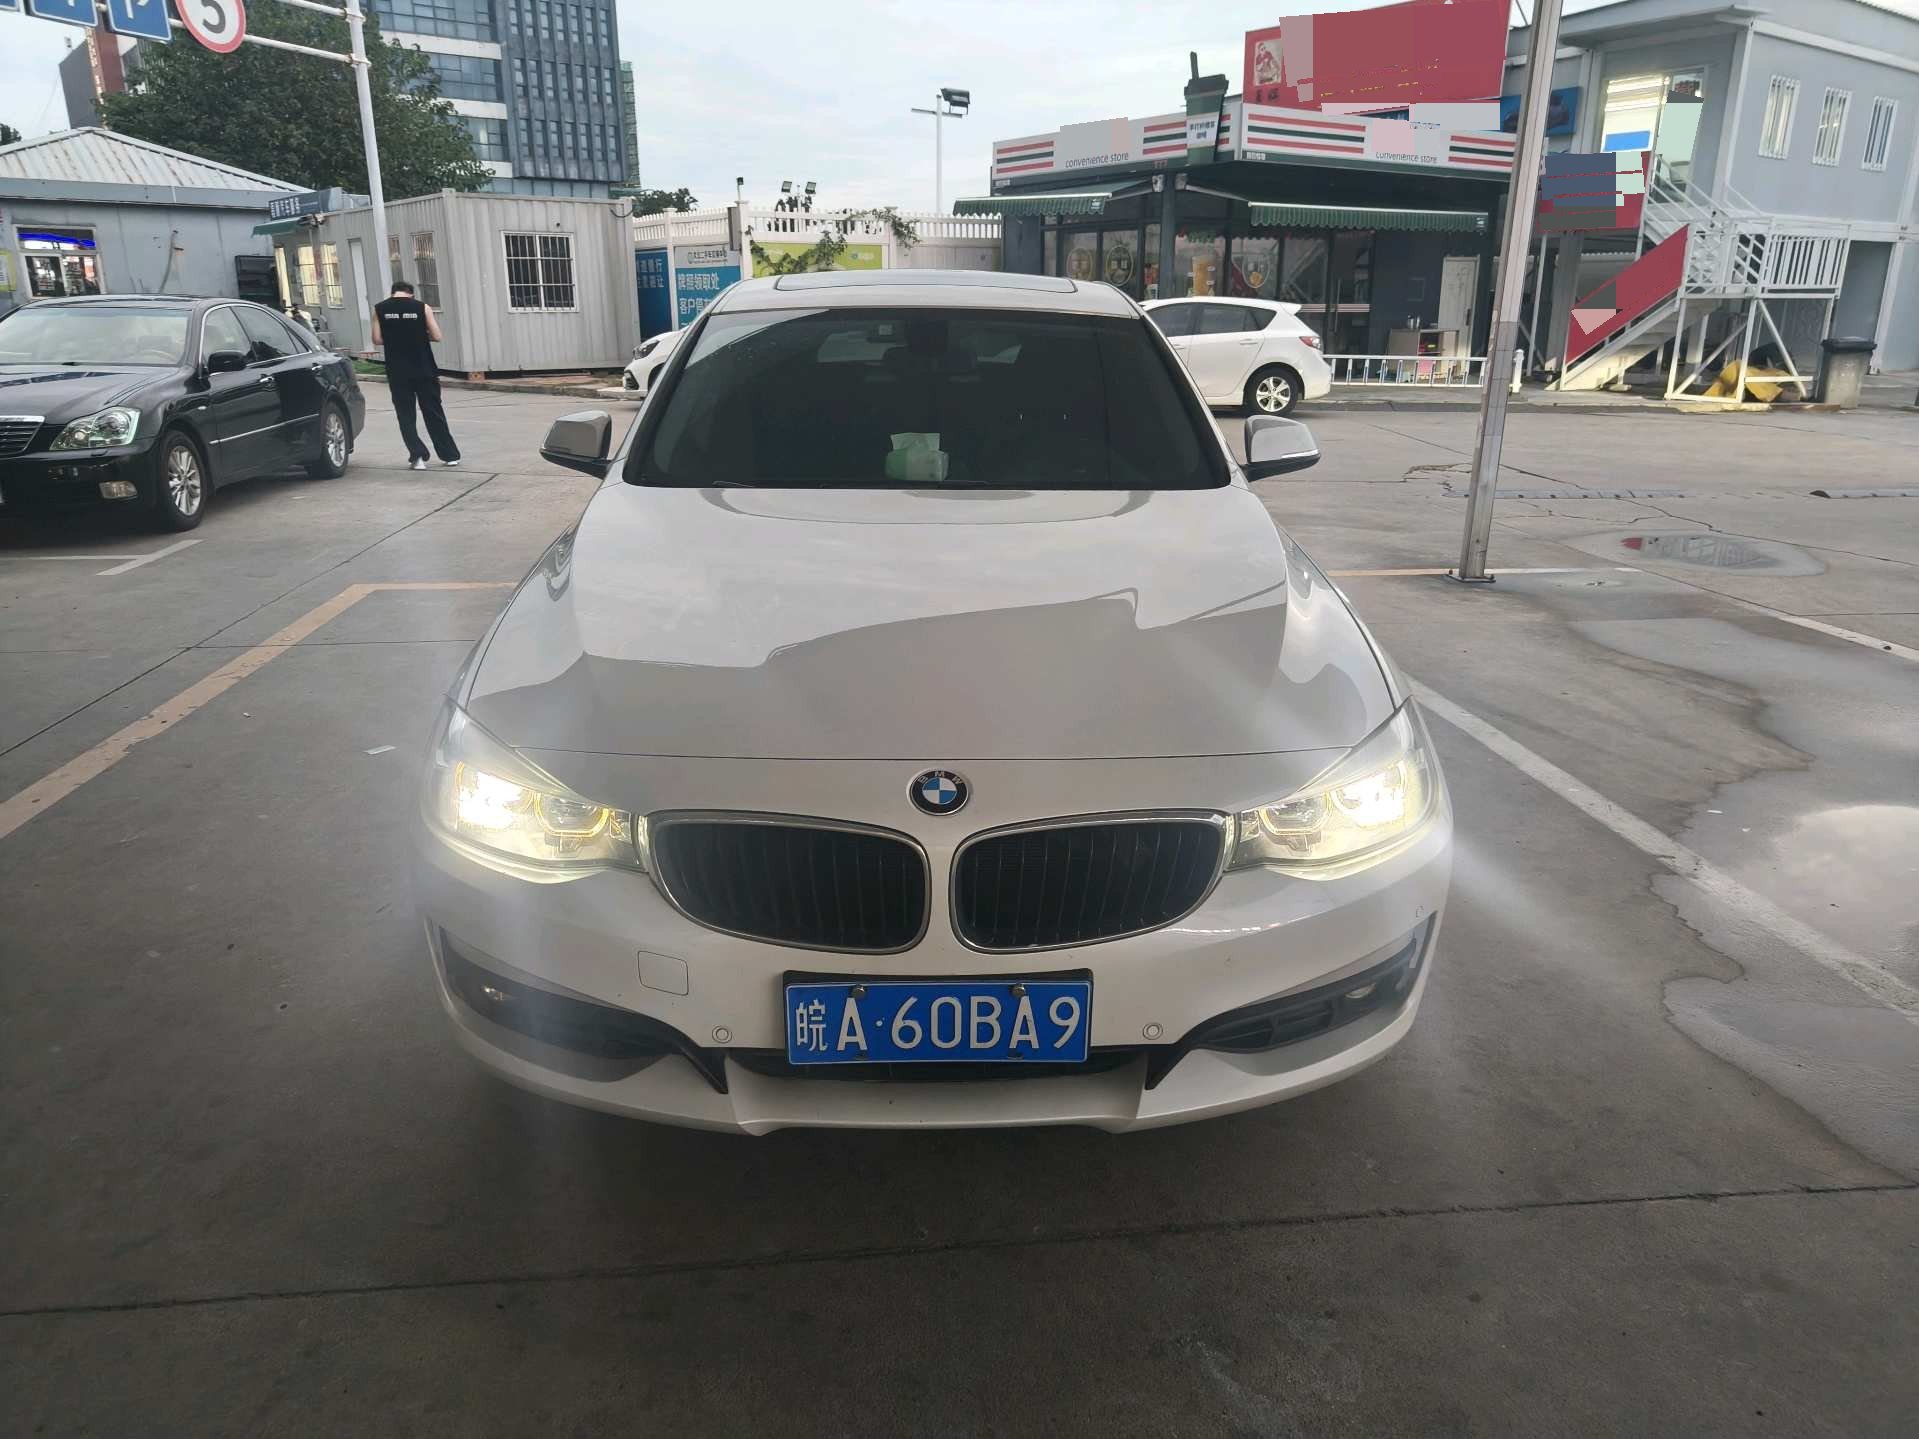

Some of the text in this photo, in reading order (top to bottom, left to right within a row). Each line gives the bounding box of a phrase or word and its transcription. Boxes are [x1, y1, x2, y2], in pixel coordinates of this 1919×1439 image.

[201, 0, 226, 34] 5
[1065, 152, 1129, 168] convenience store
[1376, 152, 1438, 164] convenience store
